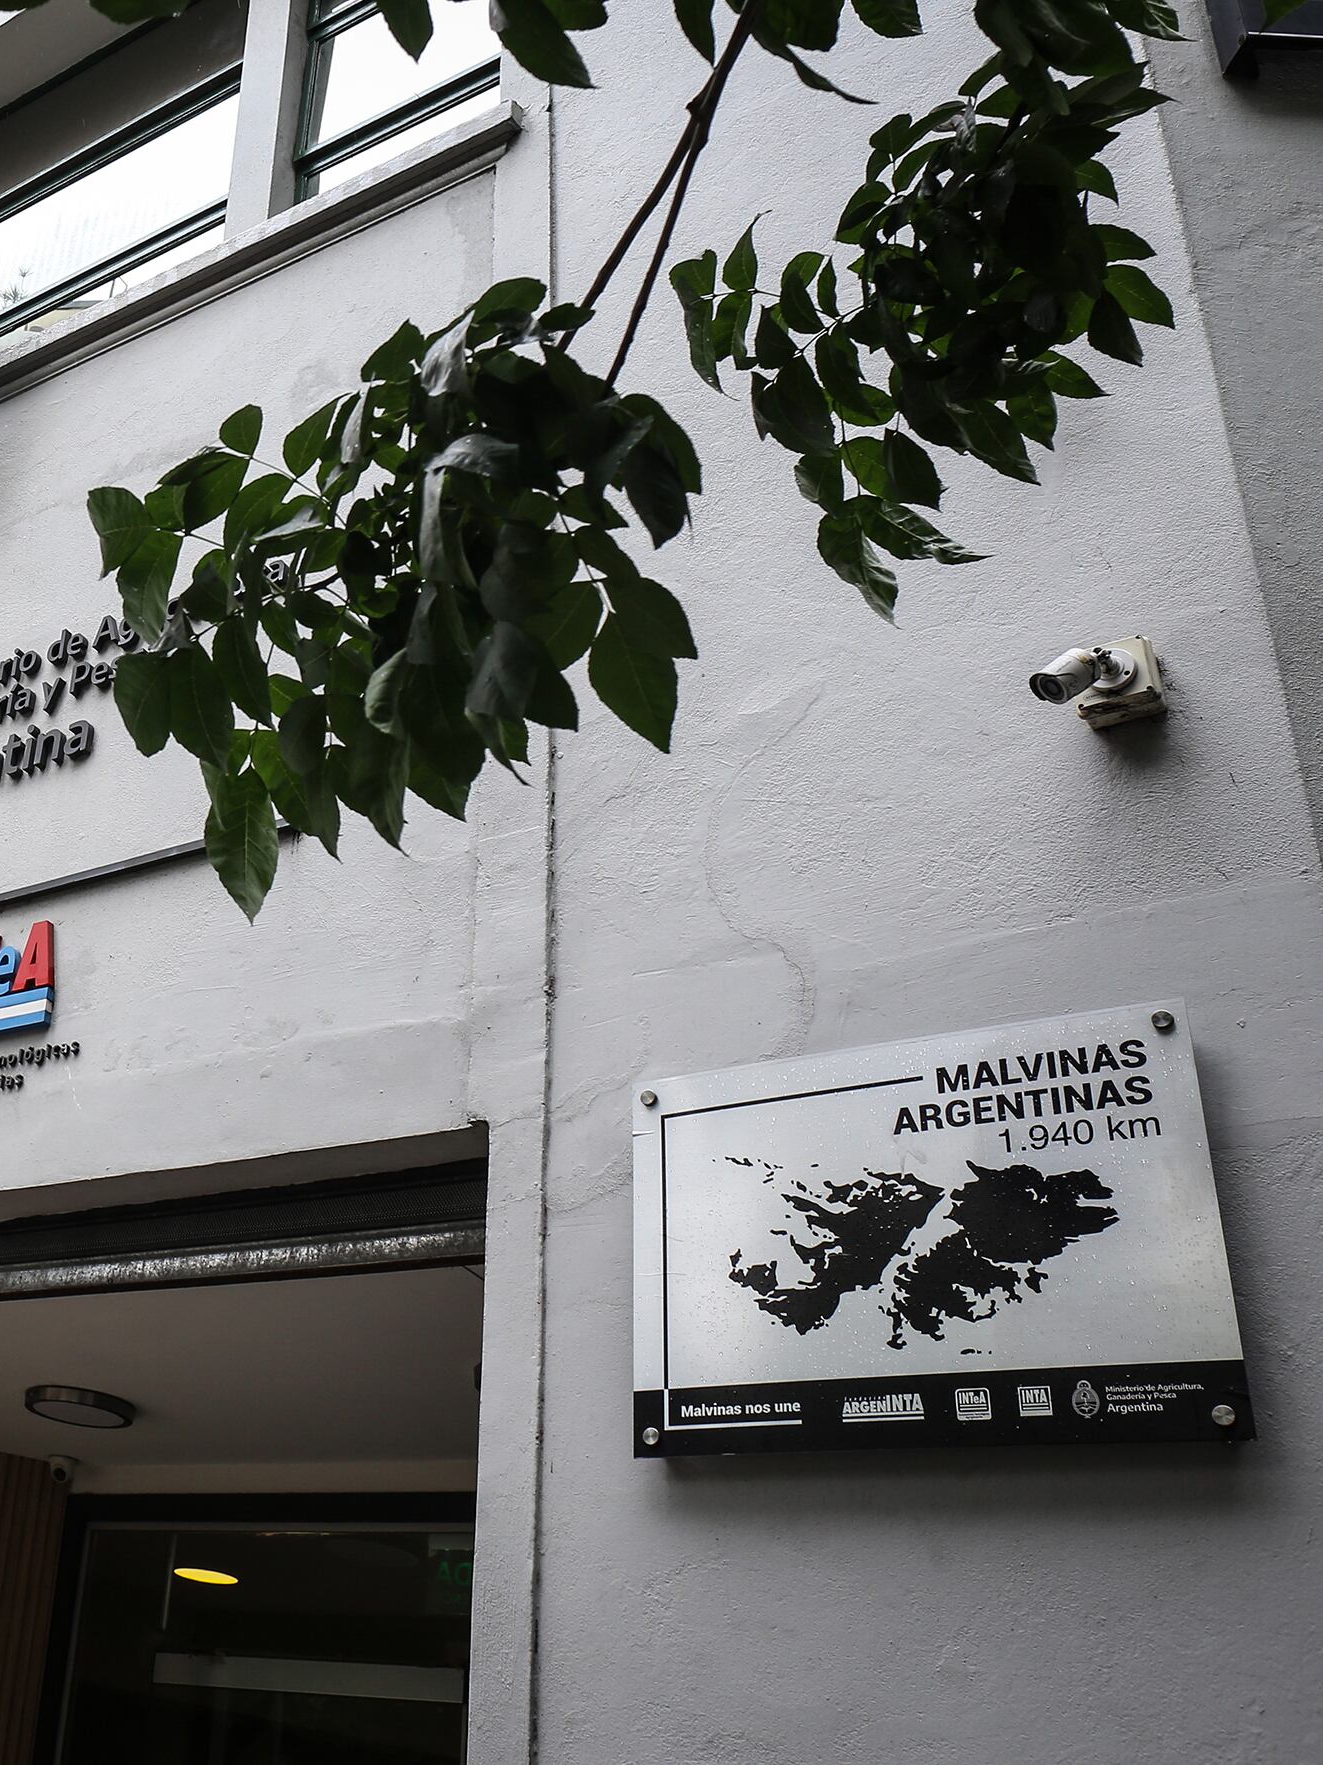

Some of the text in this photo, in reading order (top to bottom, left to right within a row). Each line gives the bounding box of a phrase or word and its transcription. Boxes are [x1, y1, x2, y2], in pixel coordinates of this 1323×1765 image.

[47, 628, 88, 666] de
[42, 677, 66, 715] y
[935, 1039, 1148, 1094] MALVINAS
[893, 1075, 1154, 1135] ARGENTINAS
[998, 1115, 1162, 1153] 1.940 km
[959, 1391, 987, 1405] INTeA
[1021, 1389, 1048, 1403] INTA
[1105, 1385, 1144, 1393] Ministerio
[680, 1401, 801, 1418] Malvinas nos une
[842, 1393, 924, 1414] ARGENINTA
[1107, 1401, 1164, 1415] Argentina
